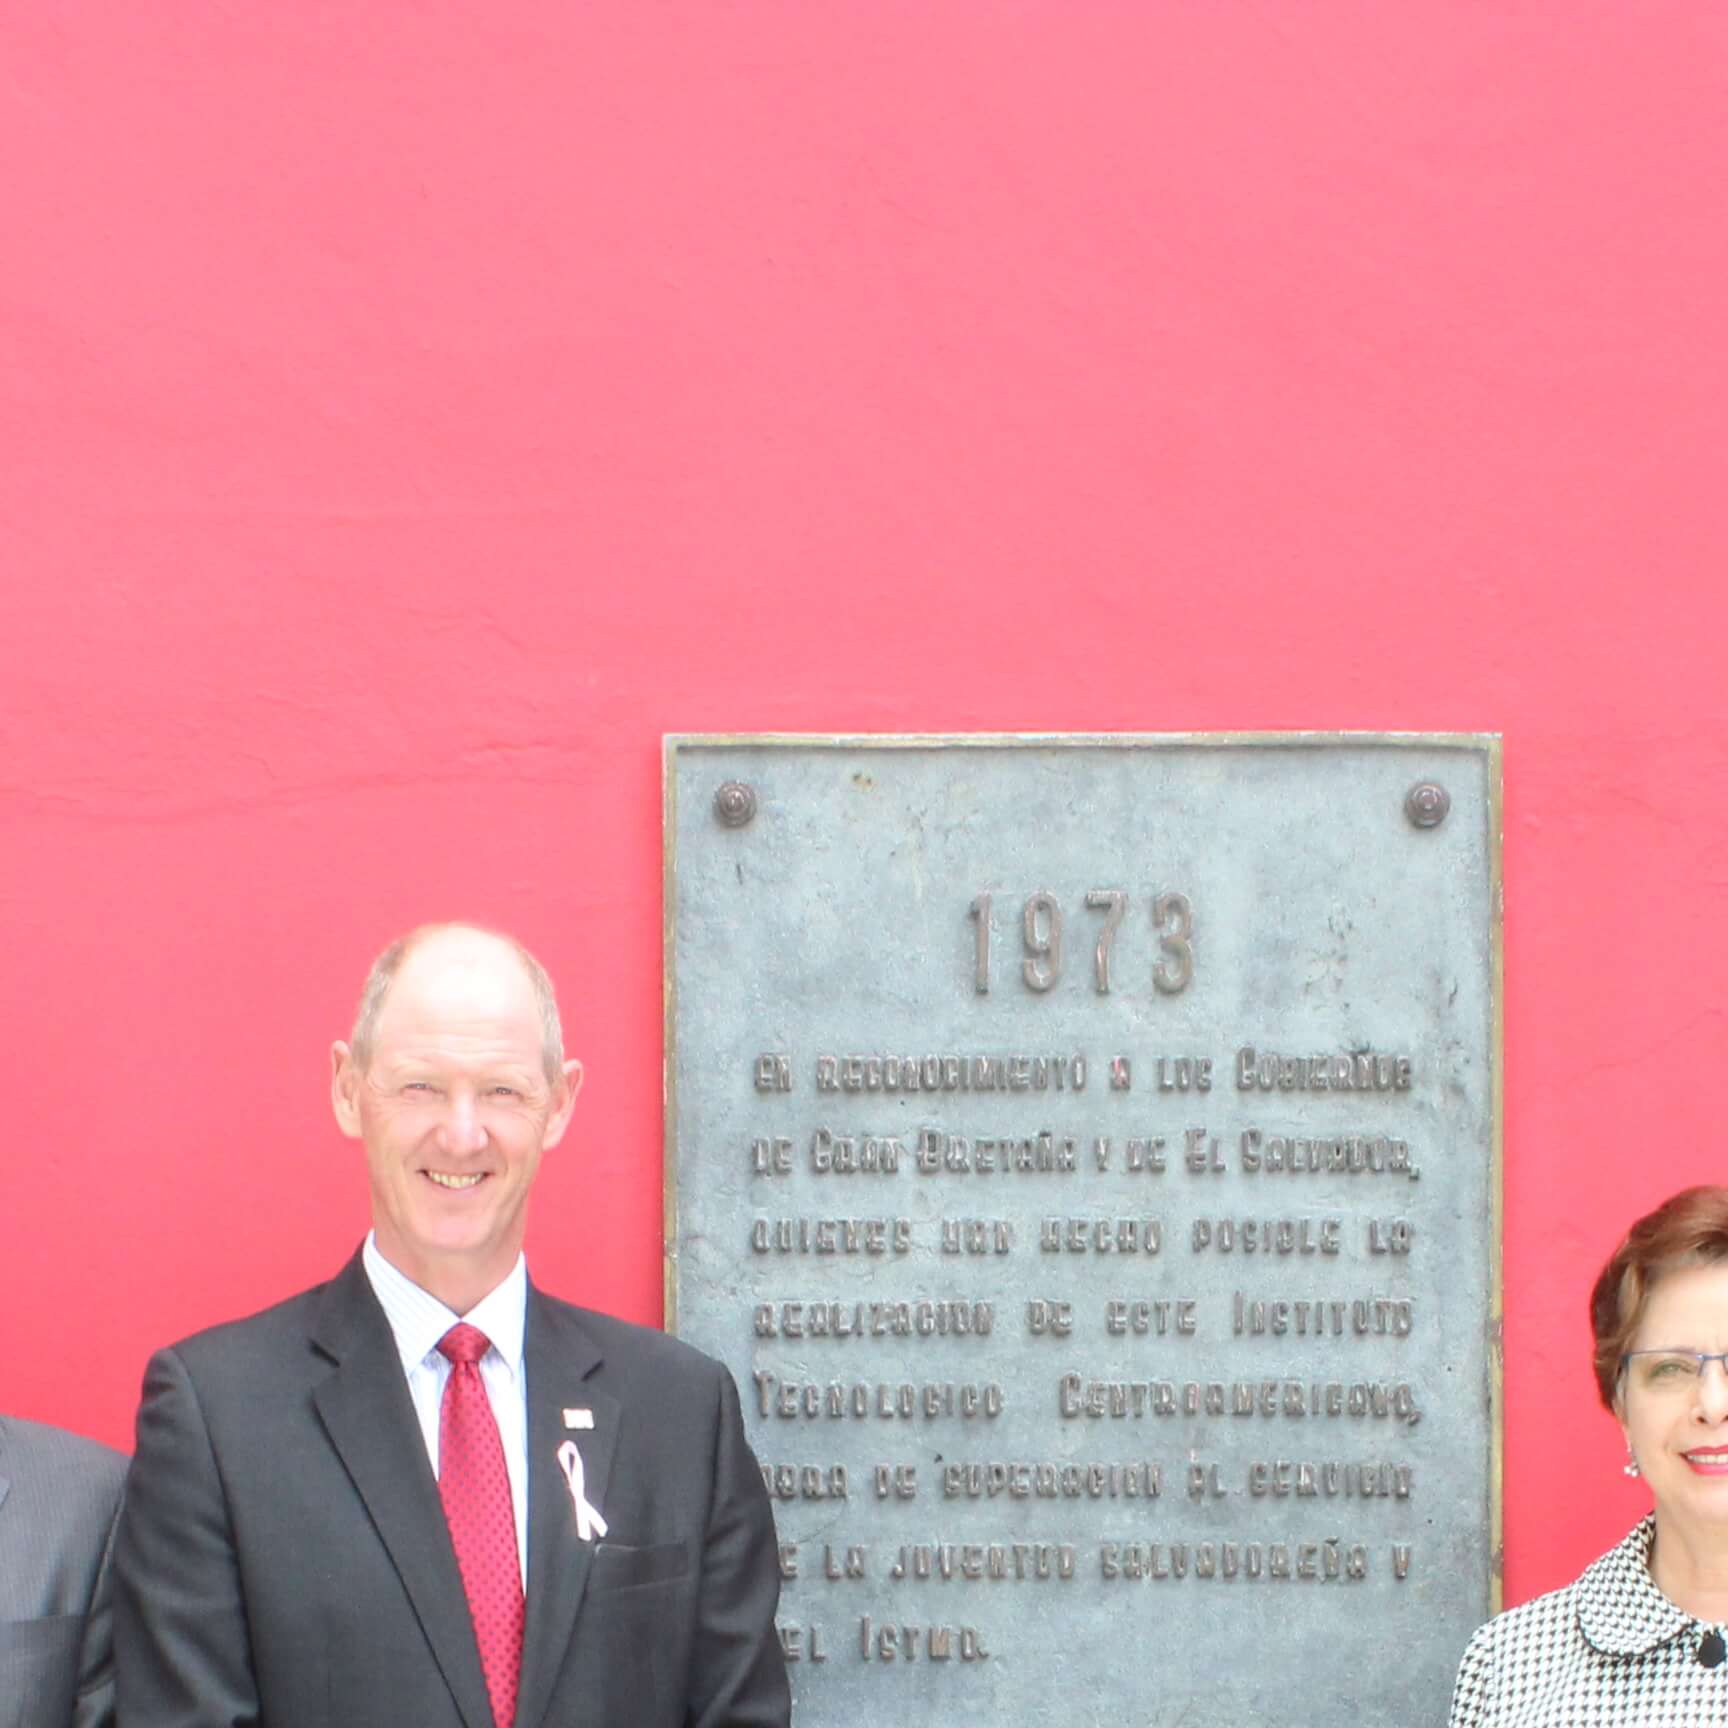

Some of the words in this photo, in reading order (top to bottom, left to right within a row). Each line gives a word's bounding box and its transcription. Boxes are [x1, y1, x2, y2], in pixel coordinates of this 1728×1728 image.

[969, 889, 1193, 995] 1973
[755, 1053, 792, 1092] EN
[817, 1055, 1087, 1092] RECONOCIMIENTO
[1111, 1056, 1131, 1092] A
[1158, 1056, 1212, 1092] LOS
[1237, 1046, 1412, 1092] GOBIERNOS
[753, 1137, 793, 1174] DE
[812, 1128, 901, 1174] GRAN
[1095, 1137, 1111, 1172] Y
[1127, 1137, 1166, 1174] DE
[1184, 1127, 1227, 1174] EL
[752, 1217, 912, 1254] QUIENES
[942, 1218, 1011, 1254] HAN
[1041, 1216, 1162, 1254] HECHO
[1192, 1218, 1340, 1254] POSIBLE
[1370, 1218, 1412, 1254] LA
[755, 1302, 992, 1337] REALIZACION
[1029, 1300, 1072, 1336] DE
[1106, 1301, 1196, 1336] ESTE
[1233, 1290, 1412, 1337] INSTITUTO
[753, 1369, 1003, 1418] TECNOLOGICO
[874, 1464, 917, 1498] DE
[943, 1463, 1162, 1498] SUPERACION
[1187, 1463, 1227, 1498] AL
[1248, 1463, 1411, 1499] SERVICIO
[825, 1544, 866, 1579] LA
[891, 1543, 1076, 1579] JUVENTUD
[1100, 1536, 1368, 1579] SALVADOREÑA
[1391, 1543, 1410, 1579] Y
